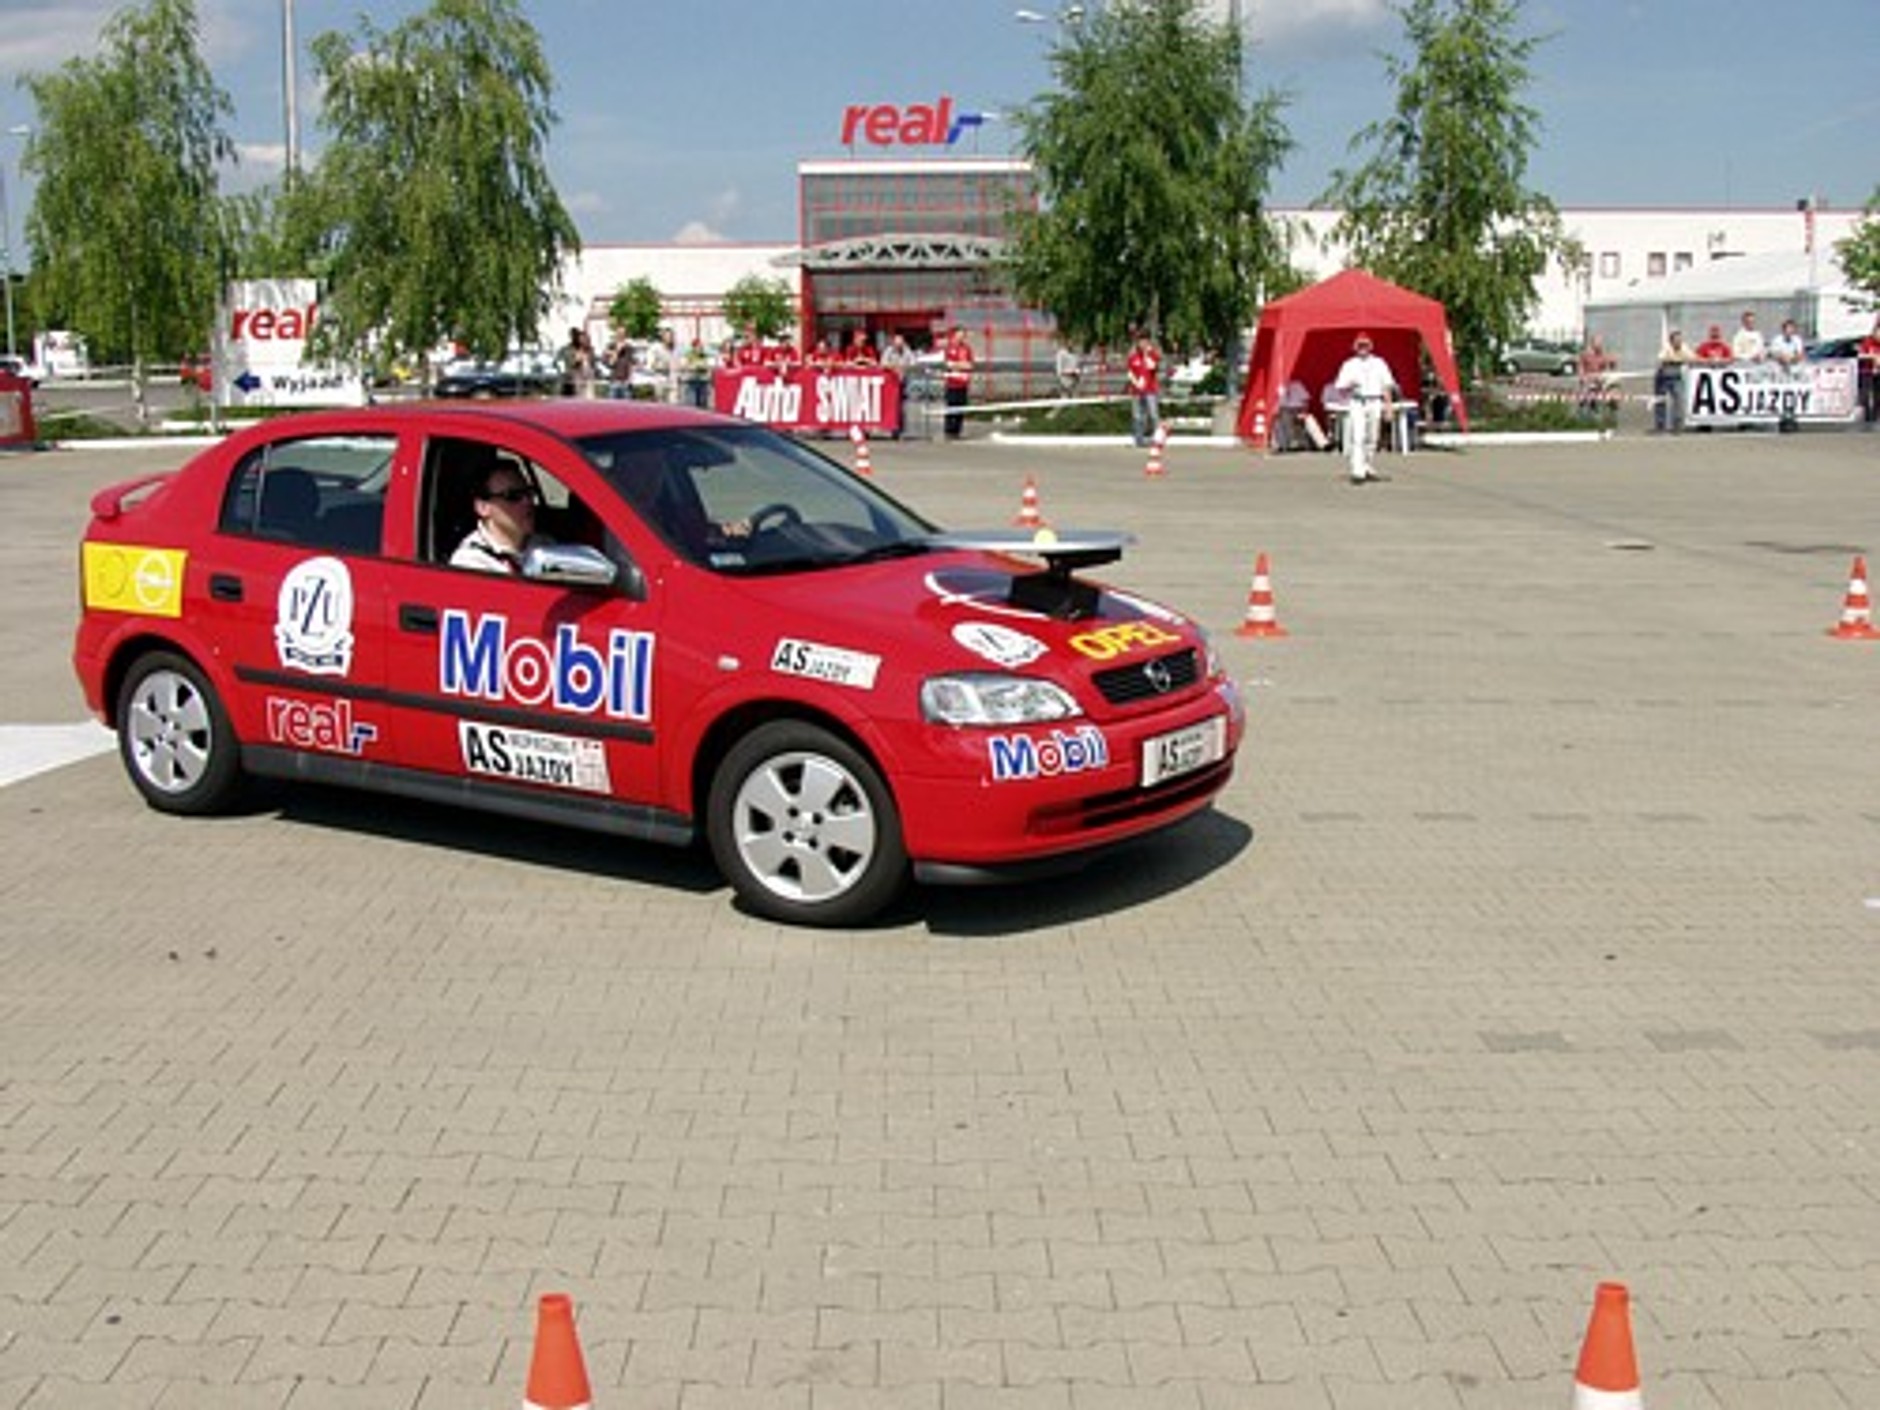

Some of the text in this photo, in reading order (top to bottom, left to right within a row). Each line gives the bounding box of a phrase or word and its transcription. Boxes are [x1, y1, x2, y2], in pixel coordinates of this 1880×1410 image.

[733, 375, 802, 422] Auto
[1692, 371, 1742, 415] AS
[441, 609, 656, 724] Mobil
[774, 643, 812, 671] AS
[466, 725, 513, 775] AS
[988, 726, 1110, 781] Mobil
